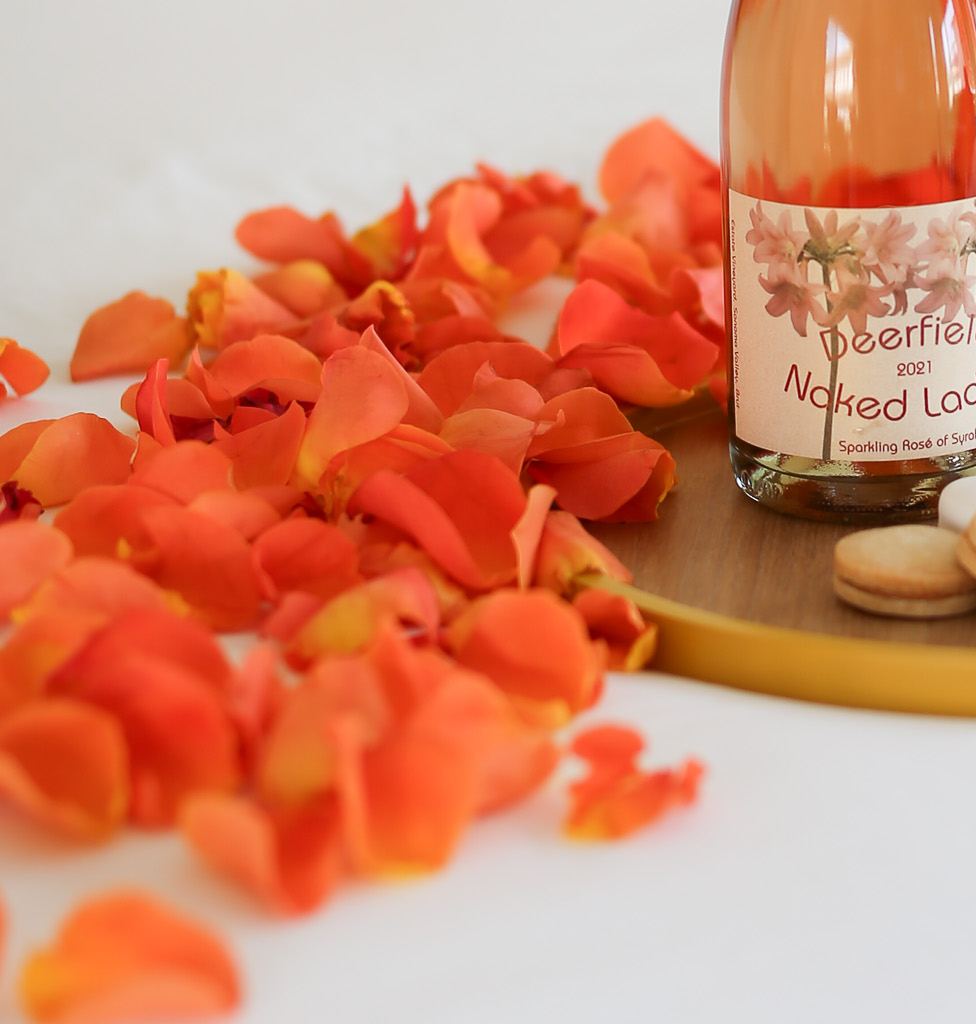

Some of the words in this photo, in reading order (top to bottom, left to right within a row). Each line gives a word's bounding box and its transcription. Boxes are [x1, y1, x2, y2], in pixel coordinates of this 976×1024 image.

[896, 360, 932, 377] 2021
[784, 363, 908, 422] Naked
[838, 440, 898, 455] Sparkling
[902, 437, 933, 452] Rosé
[936, 435, 949, 448] of
